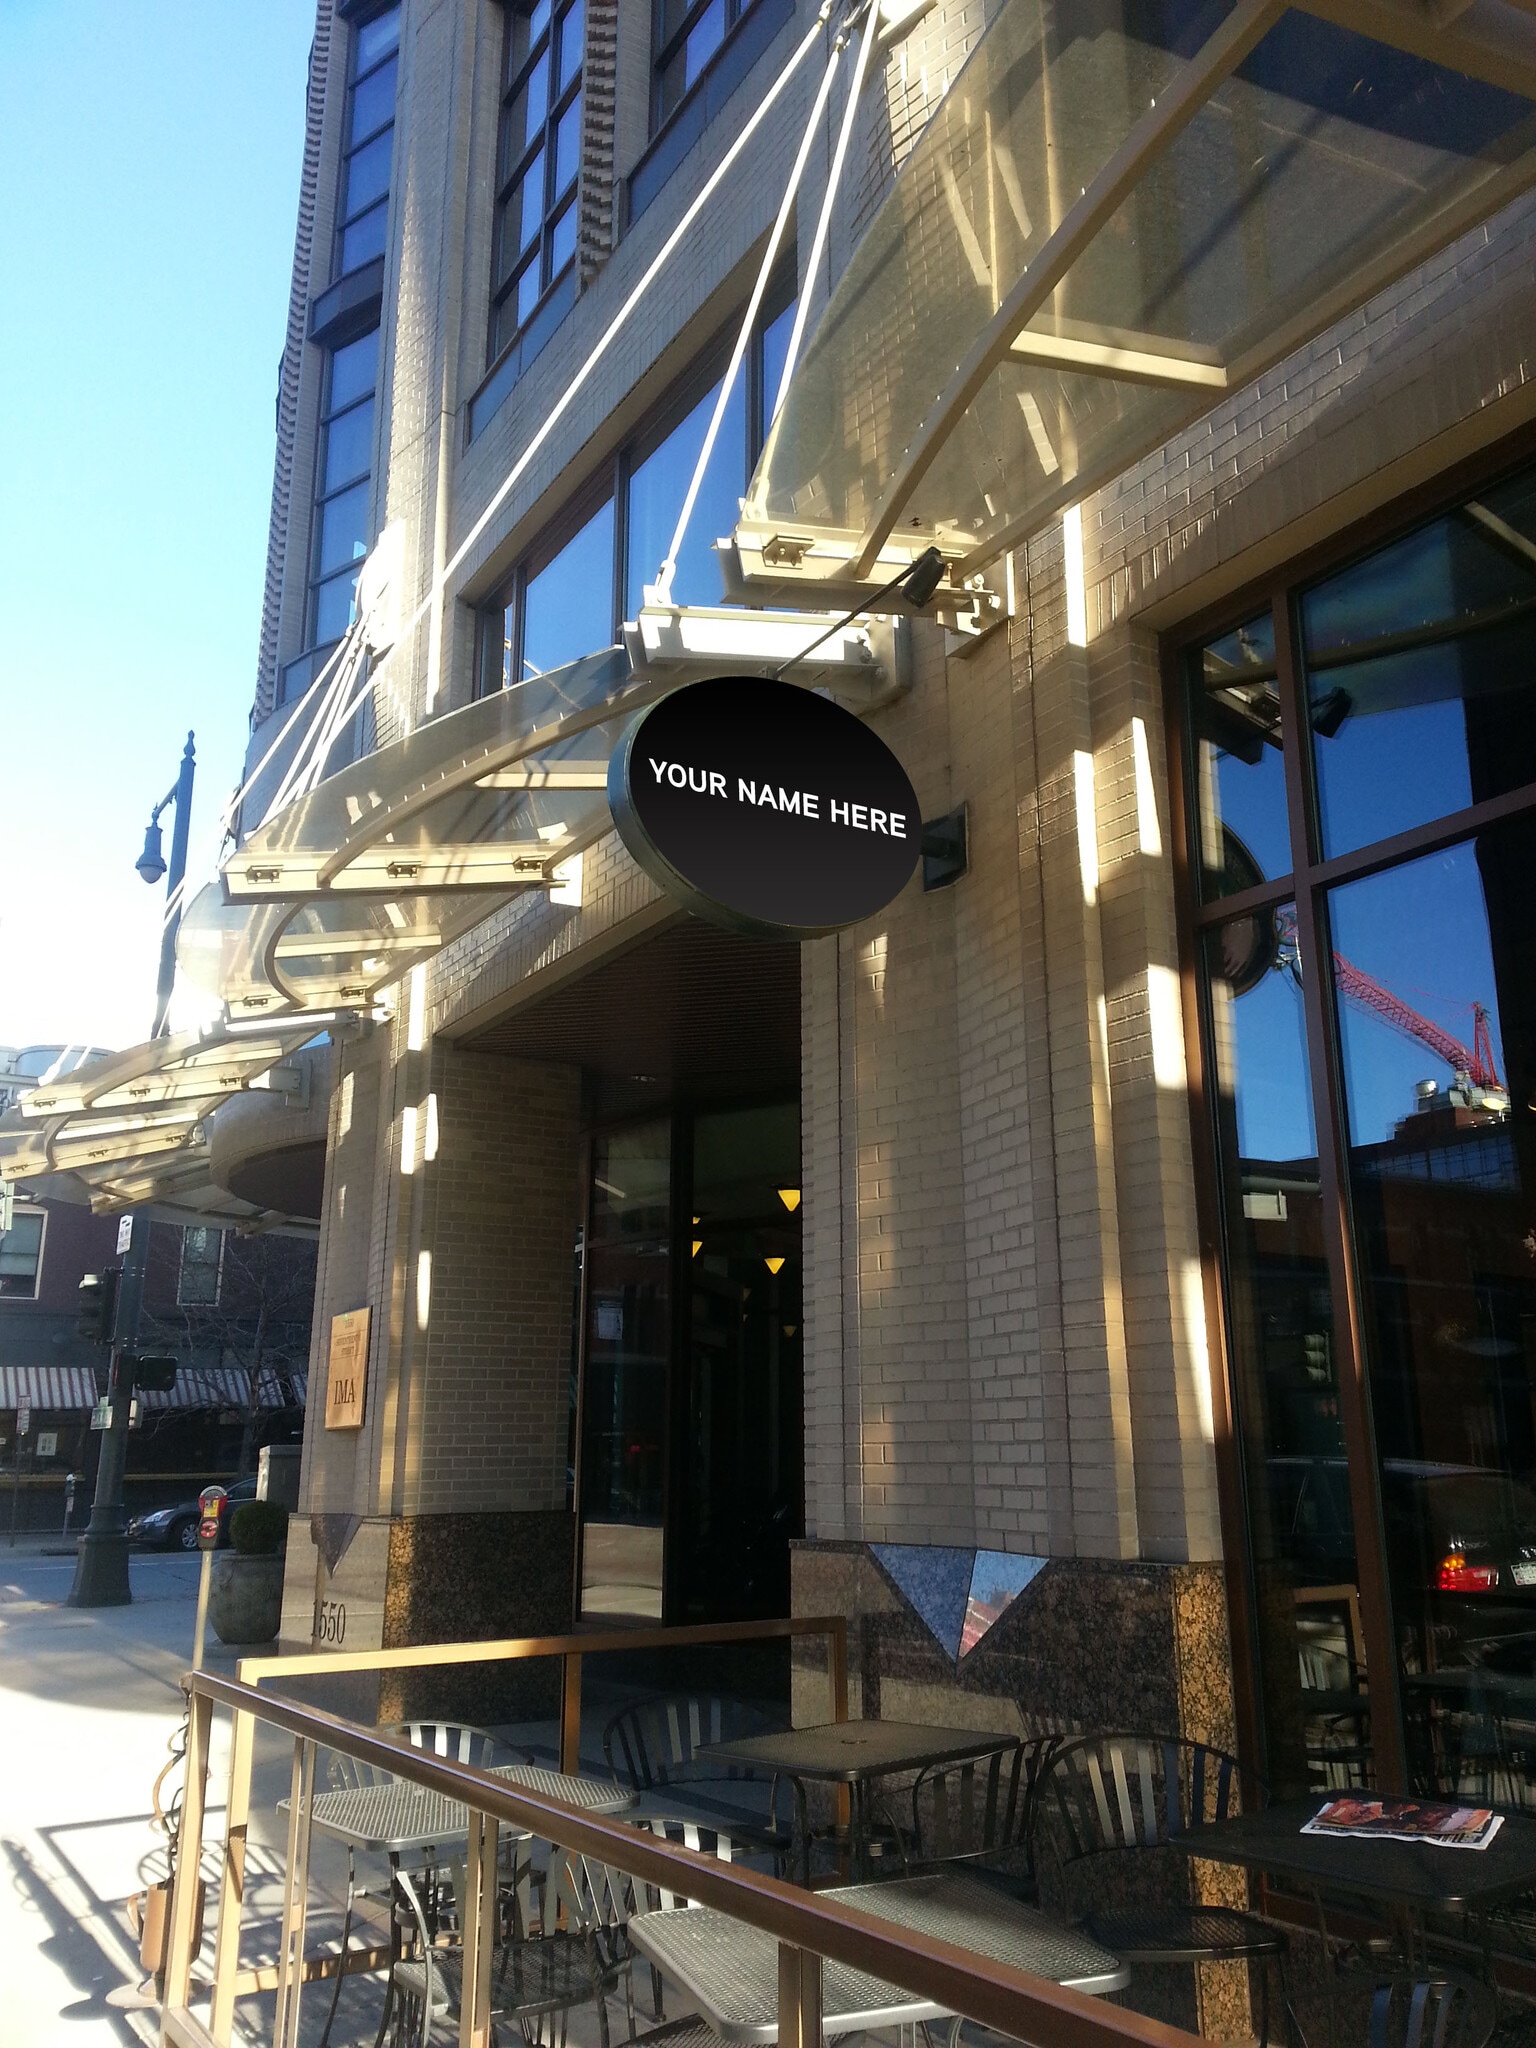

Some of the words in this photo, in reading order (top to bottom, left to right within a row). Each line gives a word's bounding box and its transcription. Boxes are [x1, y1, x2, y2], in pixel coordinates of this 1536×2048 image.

[649, 758, 728, 798] YOUR
[738, 778, 819, 819] NAME
[831, 799, 907, 838] HERE
[311, 1599, 346, 1644] 1550
